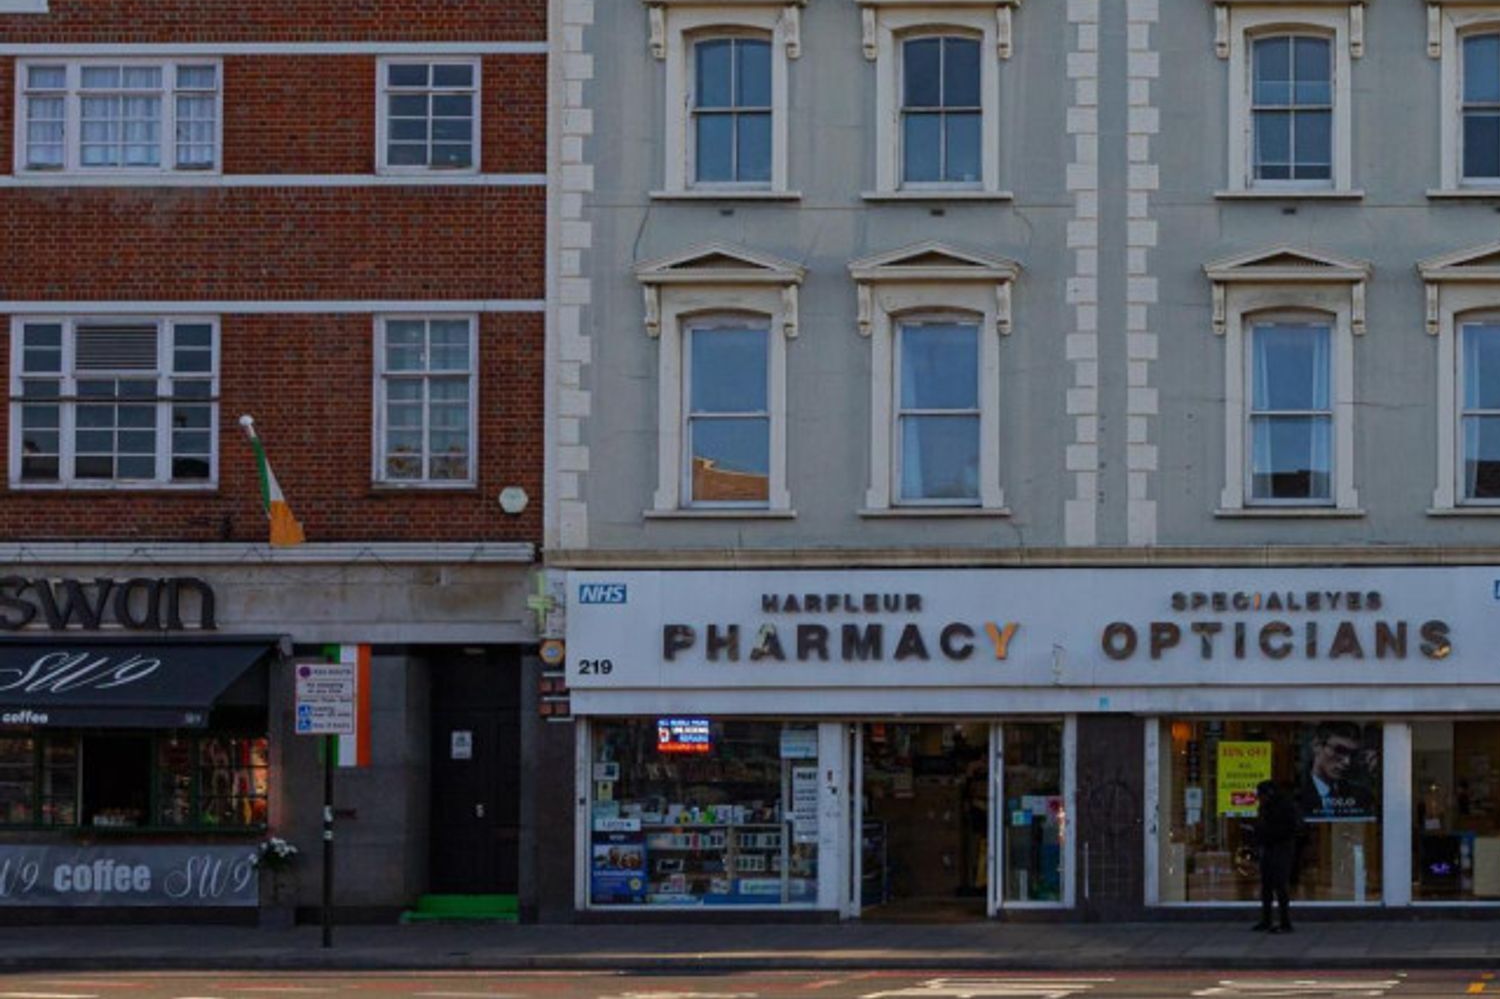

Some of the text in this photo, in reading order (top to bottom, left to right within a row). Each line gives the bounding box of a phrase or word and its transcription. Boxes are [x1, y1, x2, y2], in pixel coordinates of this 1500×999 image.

[0, 576, 217, 631] swan
[580, 585, 626, 603] NHS
[762, 594, 923, 613] HARFLEUR
[1171, 591, 1382, 611] SPECIALEYES
[663, 622, 1020, 661] PHARMACY
[1101, 620, 1453, 660] OPTICIANS
[578, 659, 613, 675] 219
[2, 710, 49, 724] coffee
[53, 858, 152, 892] coffee
[164, 854, 254, 898] SW9
